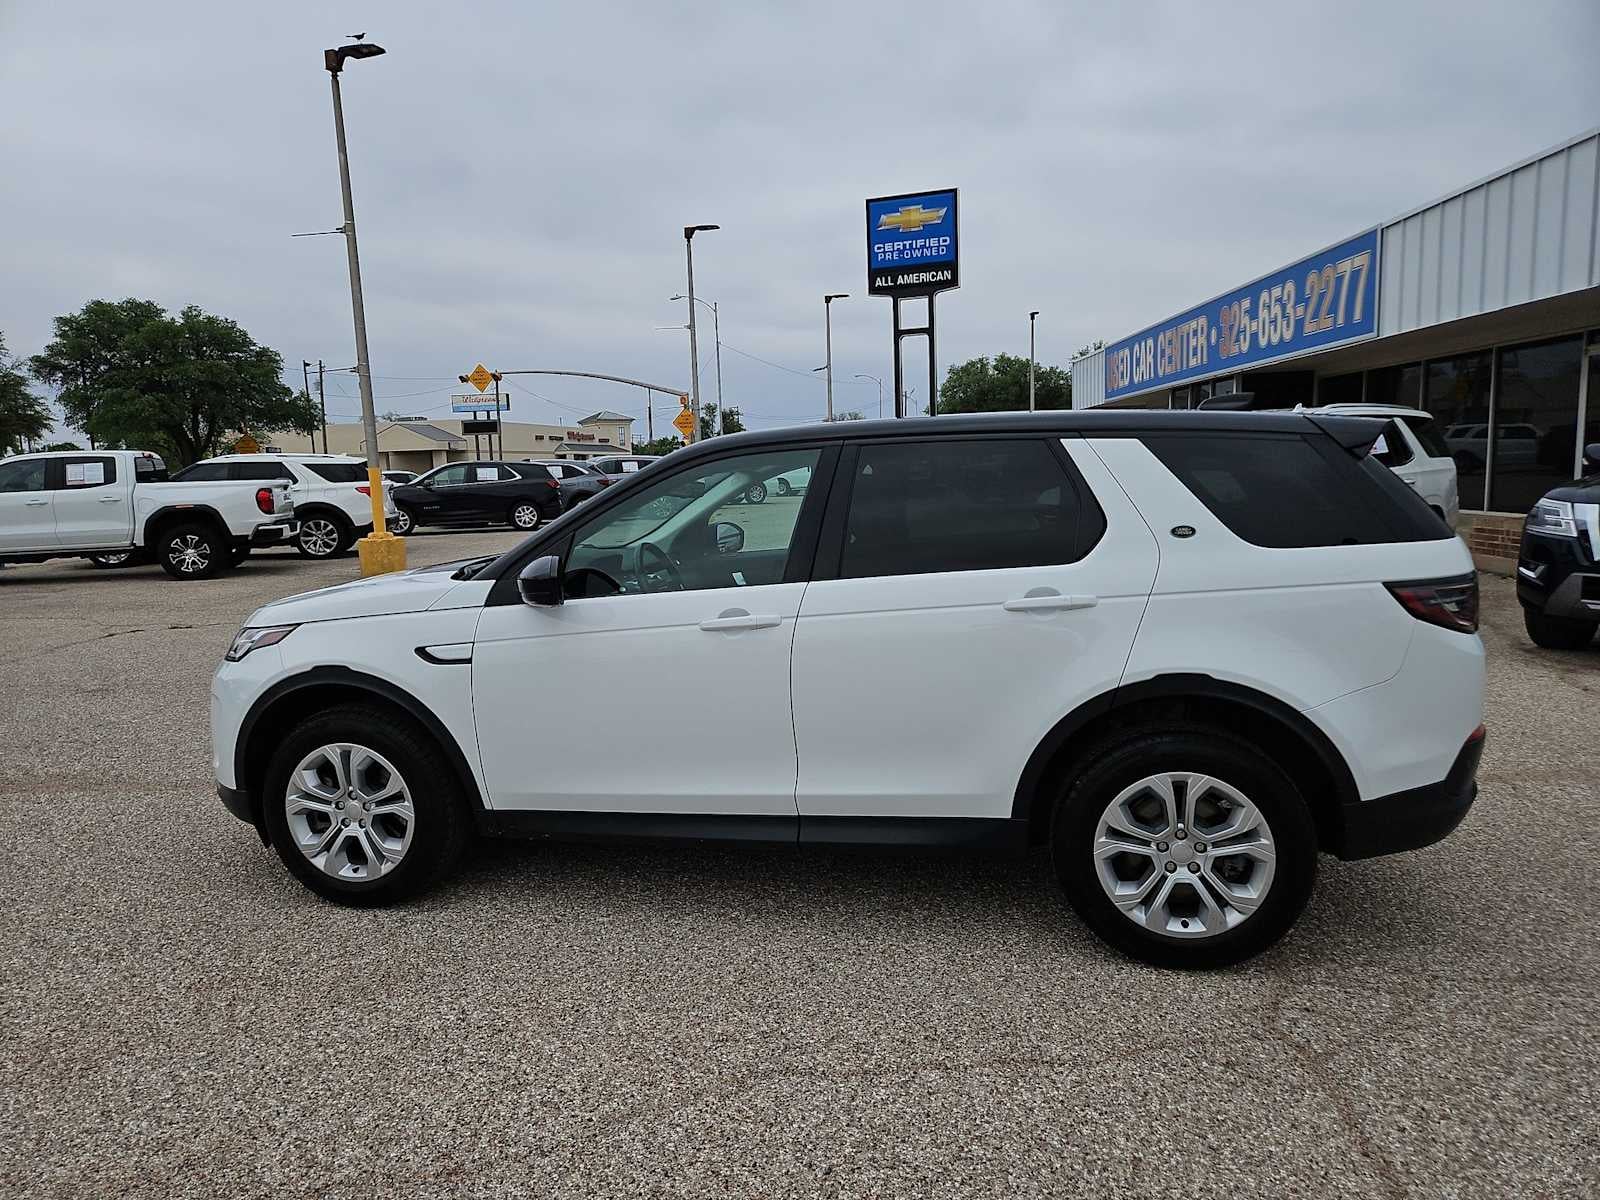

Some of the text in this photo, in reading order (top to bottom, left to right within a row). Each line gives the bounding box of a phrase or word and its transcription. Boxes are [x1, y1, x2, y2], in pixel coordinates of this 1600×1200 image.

[874, 236, 950, 253] CERTIFIED
[878, 246, 947, 261] PRE-OWNED
[875, 270, 951, 287] ALL AMERICAN
[1106, 249, 1372, 392] USED CAR CENTER 325-653-2277
